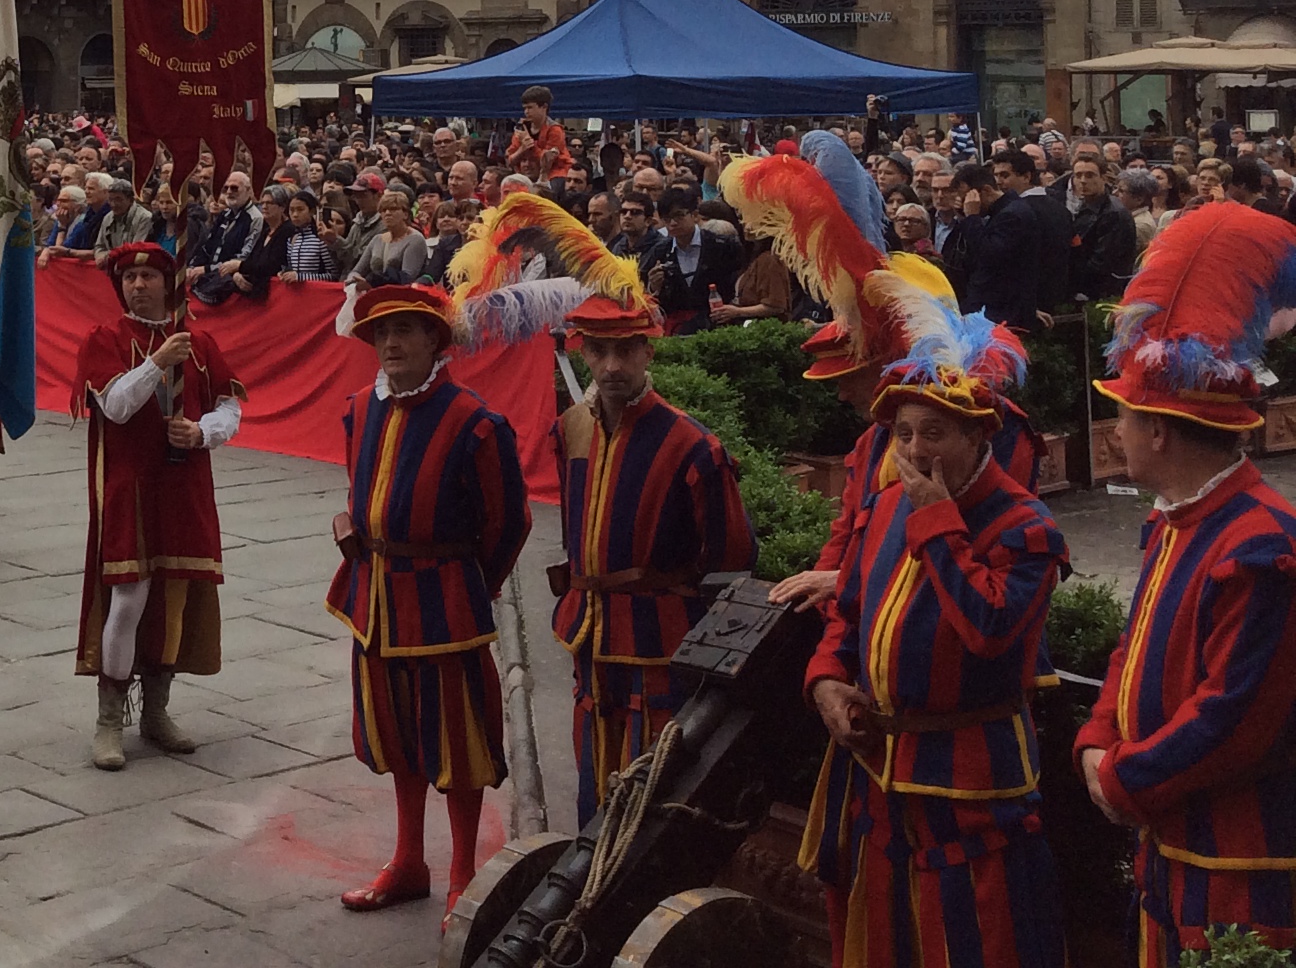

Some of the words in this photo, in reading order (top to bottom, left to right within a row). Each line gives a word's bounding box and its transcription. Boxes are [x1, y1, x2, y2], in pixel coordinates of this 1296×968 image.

[830, 13, 841, 23] DI
[843, 12, 892, 23] FIRENZE
[137, 42, 161, 67] San
[166, 57, 211, 73] Quirico
[218, 42, 257, 68] d'Orcia
[178, 80, 217, 95] Siena
[212, 103, 243, 120] Italy
